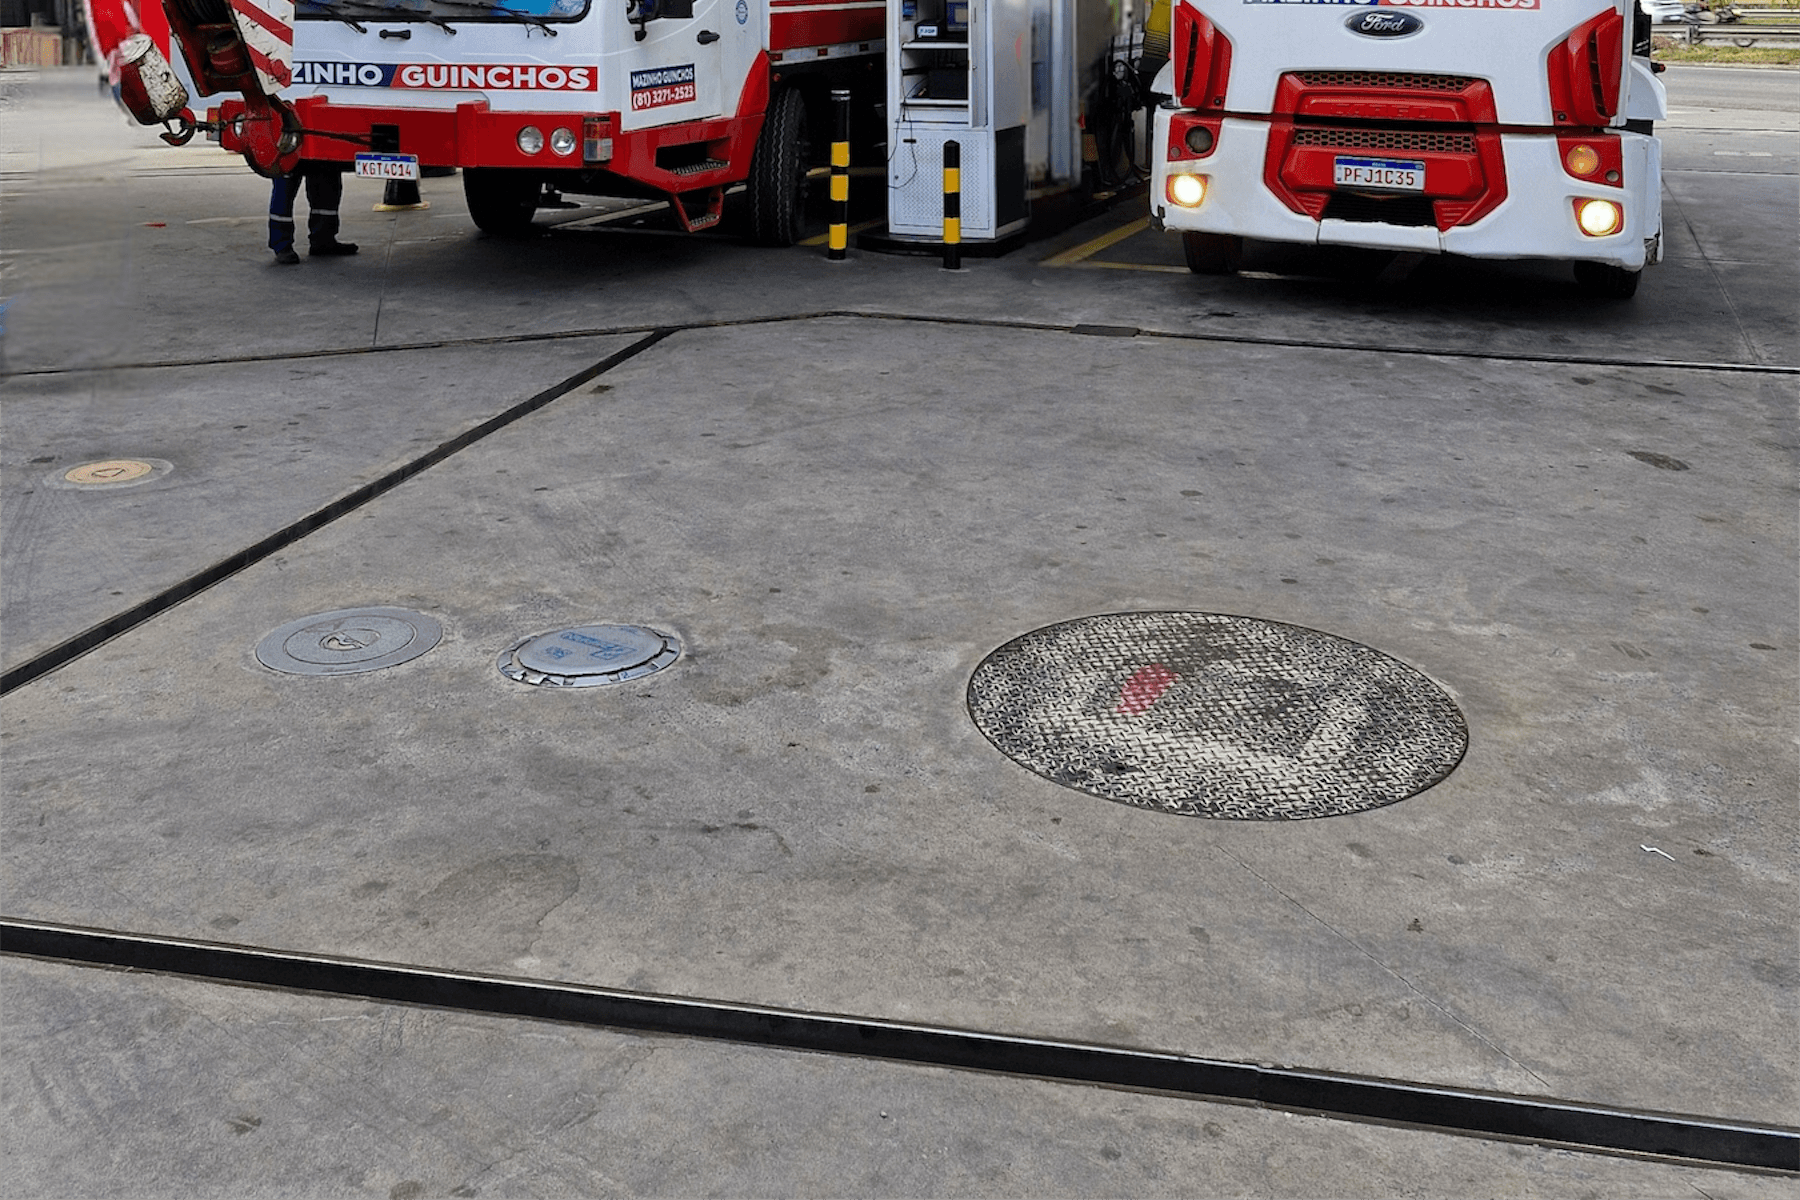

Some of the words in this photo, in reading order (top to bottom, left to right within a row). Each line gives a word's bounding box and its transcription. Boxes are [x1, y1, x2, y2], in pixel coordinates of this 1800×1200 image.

[1361, 12, 1403, 32] Ford
[292, 62, 383, 85] ZINHO
[401, 65, 590, 90] GUINCHOS
[632, 72, 661, 88] MAZINHO
[663, 67, 693, 84] GUINCHOS
[633, 91, 651, 109] (81)
[652, 85, 694, 104] 3271-2523
[362, 162, 412, 177] KGT4C14
[1344, 167, 1414, 186] PFJ1C35
